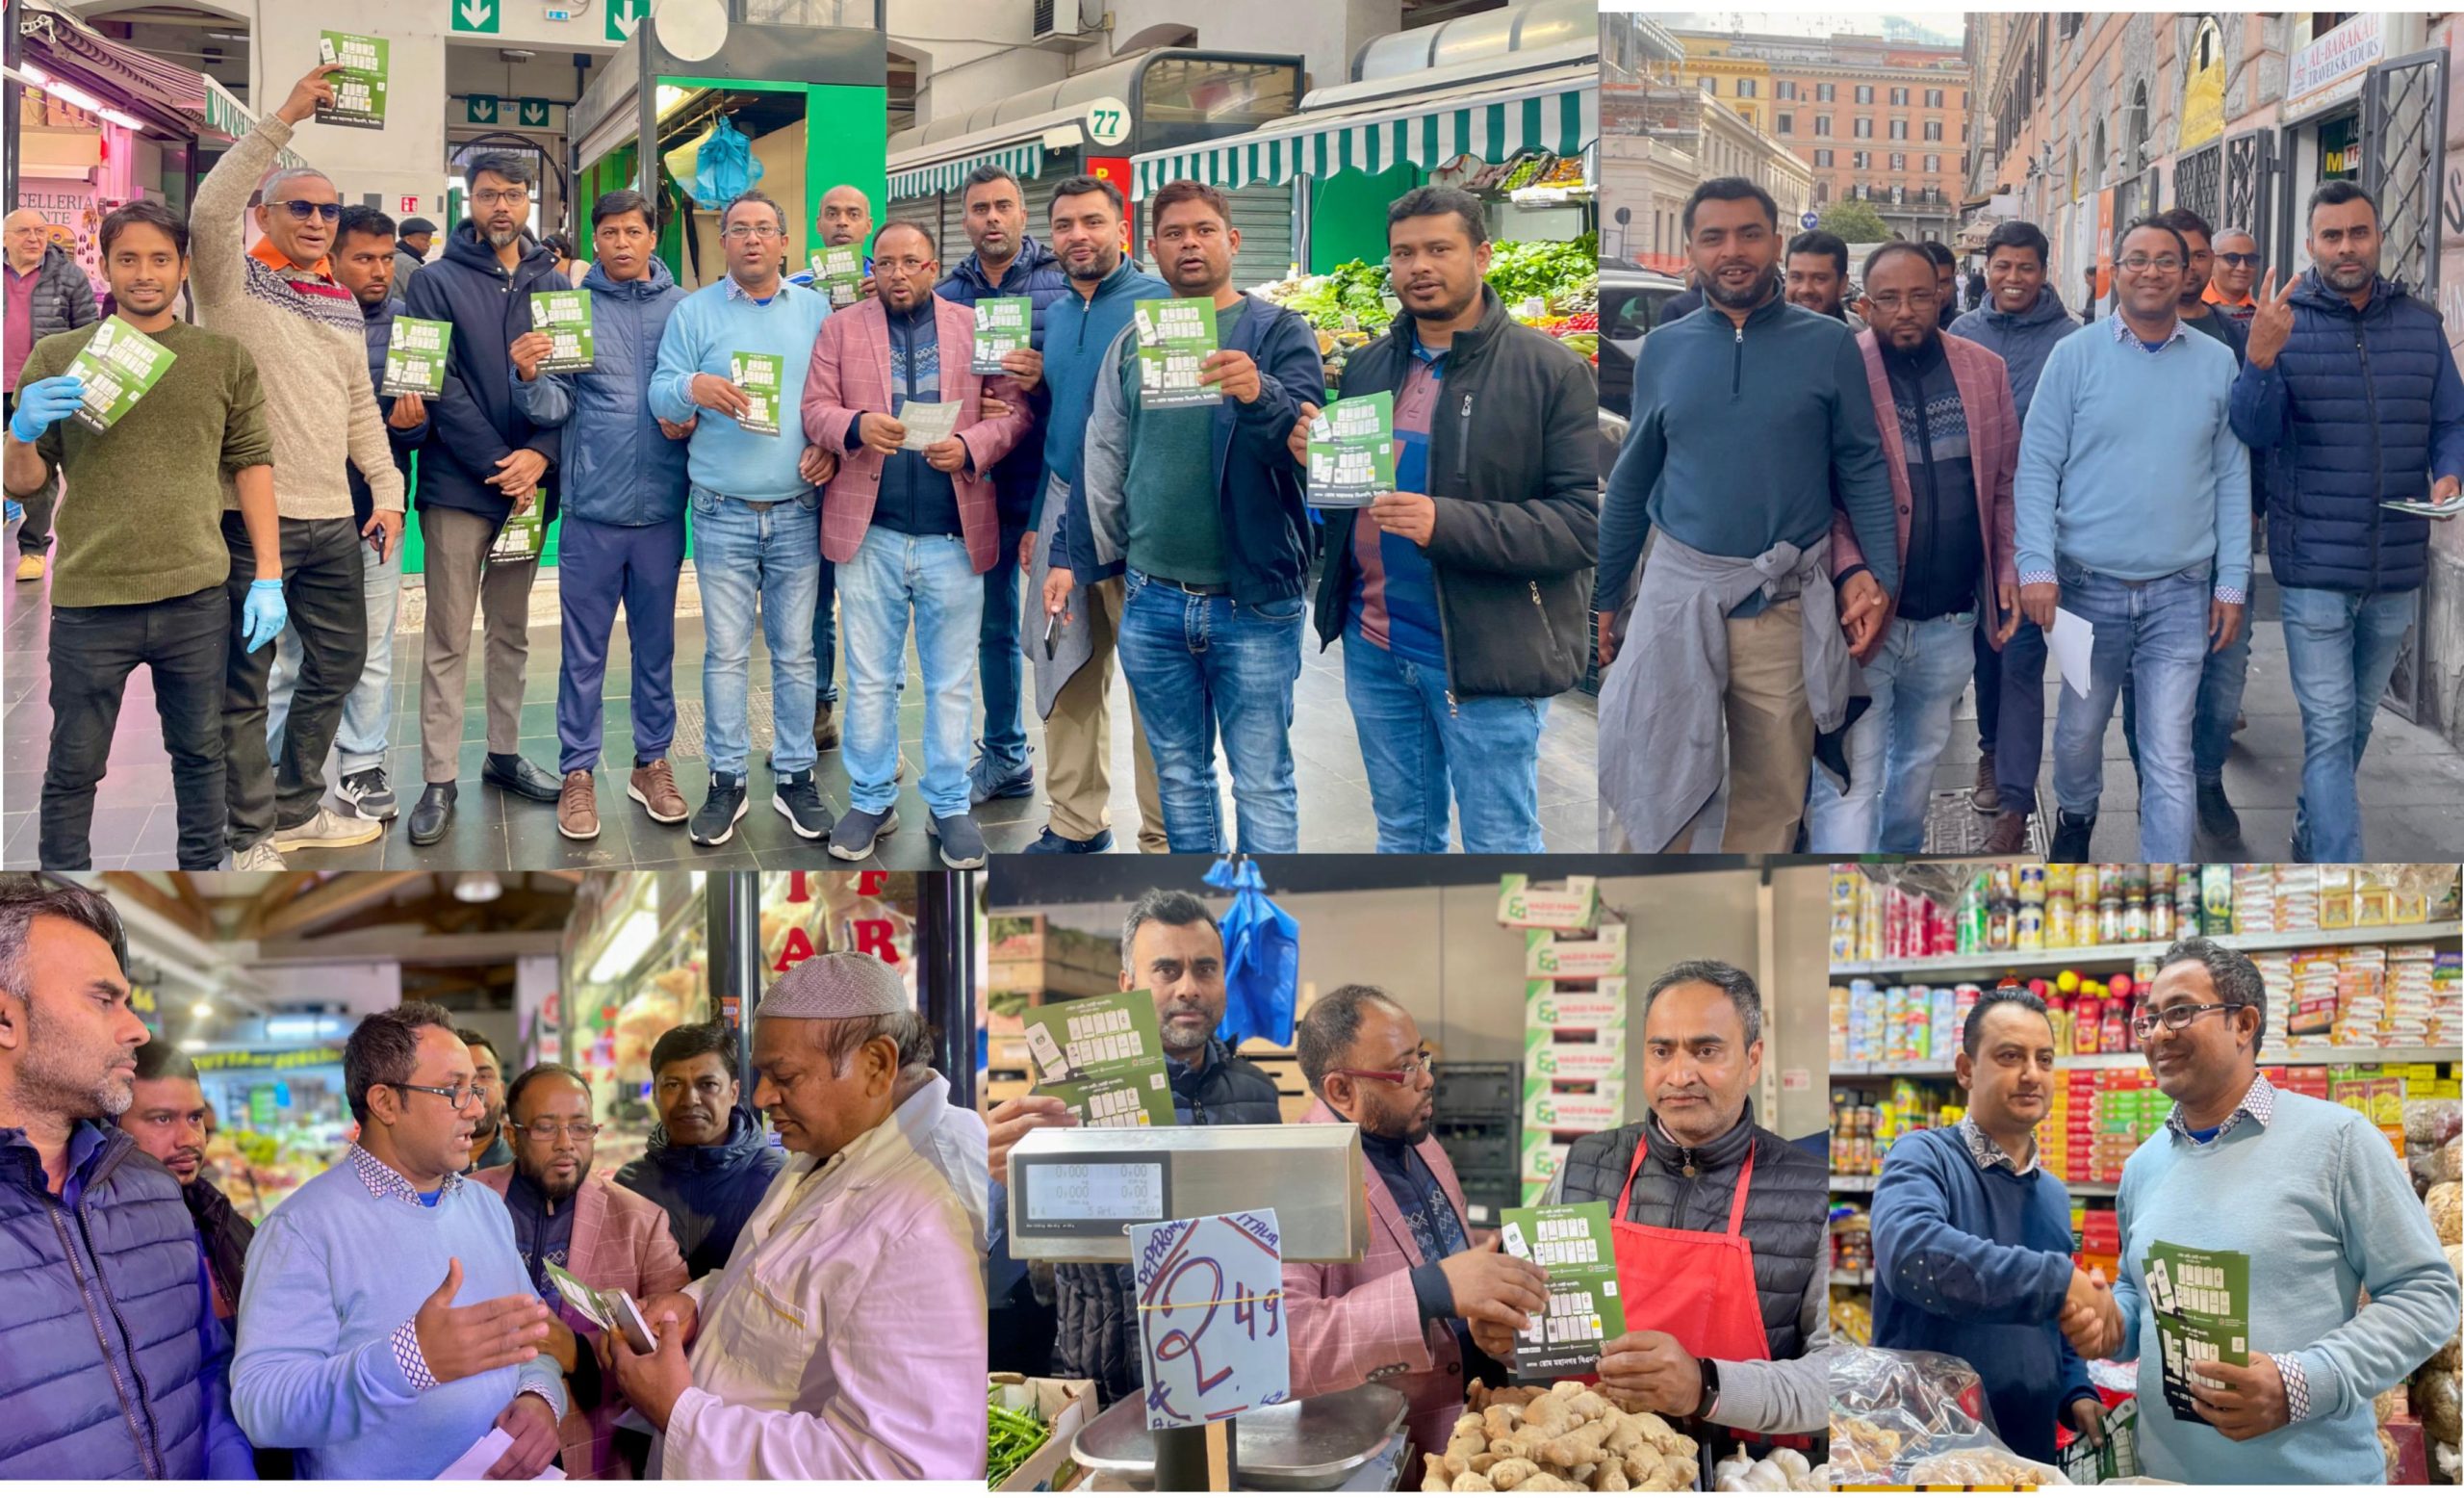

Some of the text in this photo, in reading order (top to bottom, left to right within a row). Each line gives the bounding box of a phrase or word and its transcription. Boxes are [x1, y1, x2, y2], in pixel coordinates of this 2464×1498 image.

[2309, 57, 2340, 87] TRAVELS
[2341, 56, 2348, 70] &
[2349, 38, 2378, 65] TOURS
[2310, 13, 2378, 67] AL-BARAKAH
[1093, 110, 1120, 134] 77
[1236, 1214, 1279, 1247] ITALIA
[1235, 1281, 1279, 1341] 49
